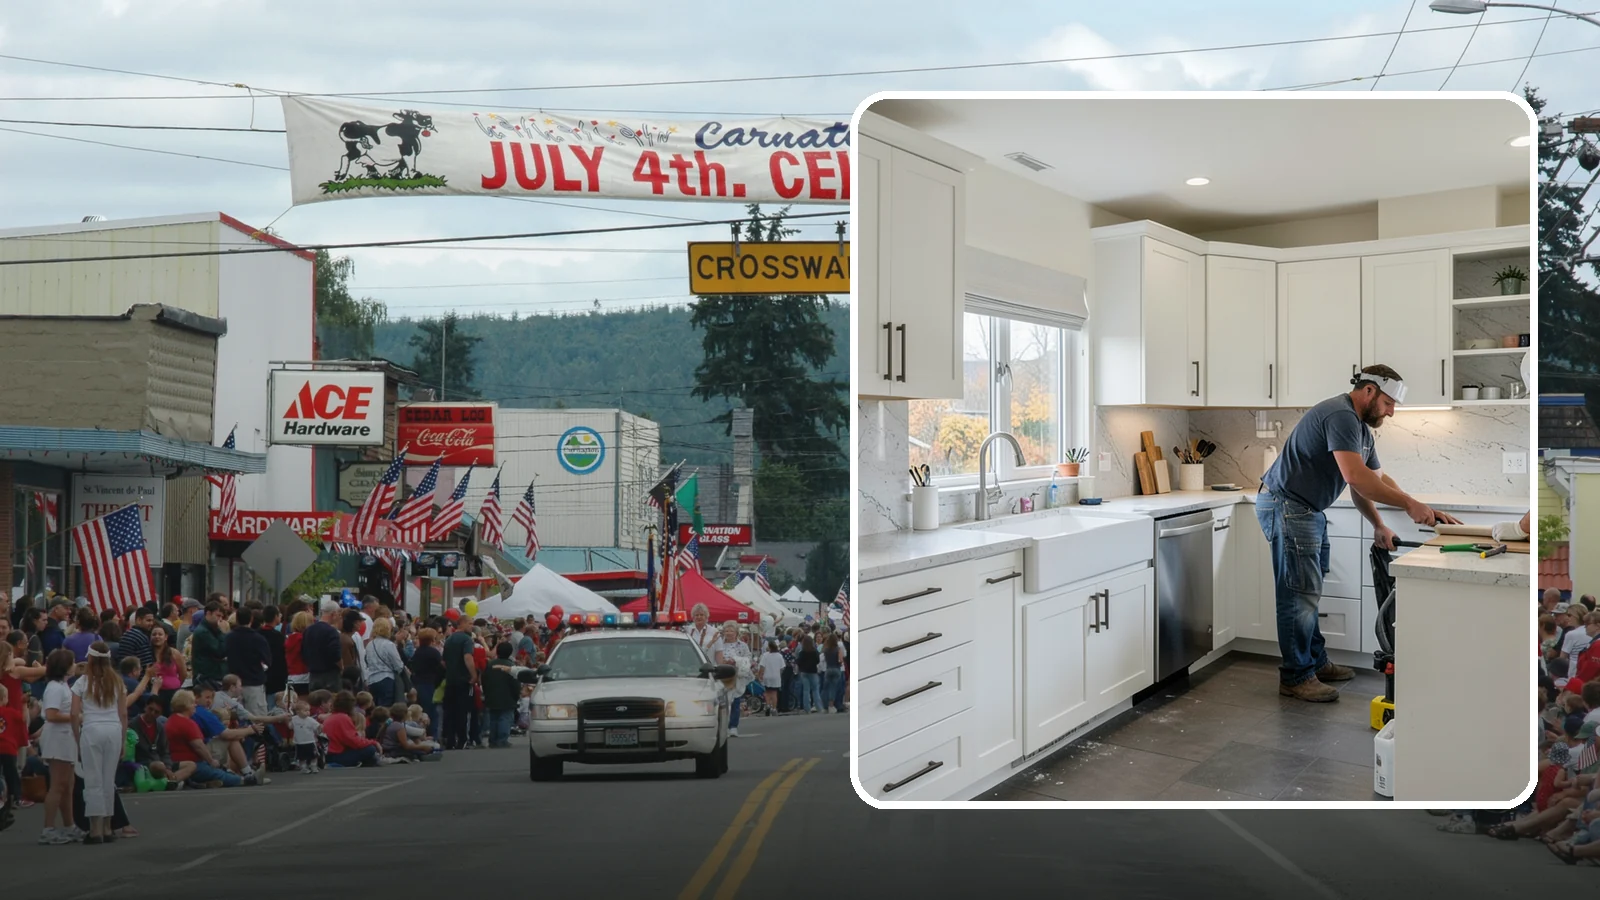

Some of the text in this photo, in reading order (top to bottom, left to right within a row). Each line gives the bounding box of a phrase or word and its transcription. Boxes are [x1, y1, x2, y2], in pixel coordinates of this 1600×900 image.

[481, 141, 604, 192] JULY
[632, 149, 746, 197] 4th.
[697, 254, 850, 279] CROSSWA
[283, 380, 373, 420] ACE
[405, 409, 453, 422] CEDAR
[283, 421, 371, 436] Hardware
[416, 428, 477, 447] Coca-Cola
[95, 485, 124, 494] Vincent
[126, 486, 136, 494] de
[138, 486, 155, 495] Paul
[212, 515, 331, 536] HARDARE
[688, 526, 741, 535] CRNATION
[699, 535, 730, 543] GLASS
